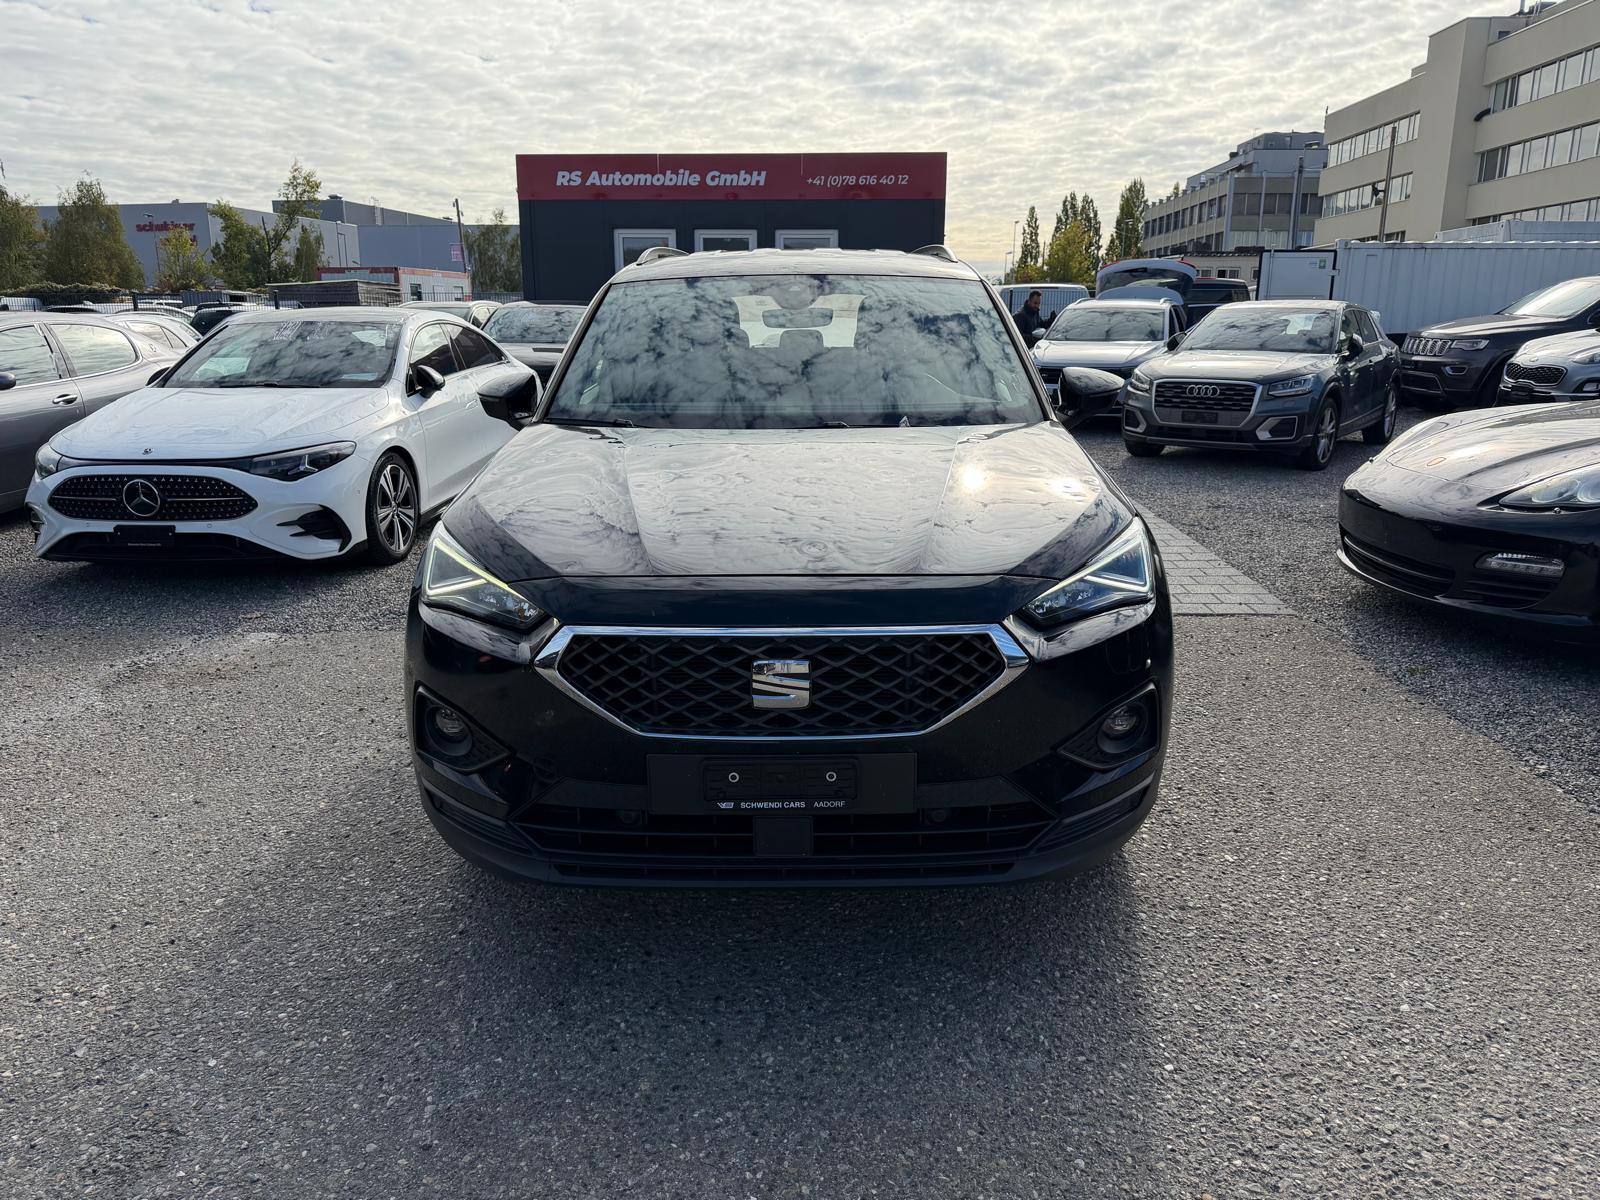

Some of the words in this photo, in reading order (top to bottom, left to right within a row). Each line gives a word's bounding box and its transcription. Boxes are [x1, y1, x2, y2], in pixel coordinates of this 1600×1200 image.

[556, 170, 582, 186] RS
[585, 168, 701, 186] Automobile
[705, 170, 767, 186] GmbH
[806, 175, 825, 186] +41
[827, 175, 857, 188] (0)78
[858, 175, 877, 185] 616
[879, 174, 896, 185] 40
[897, 174, 909, 185] 12
[740, 801, 782, 809] SCHWENDI
[783, 801, 806, 809] CARS
